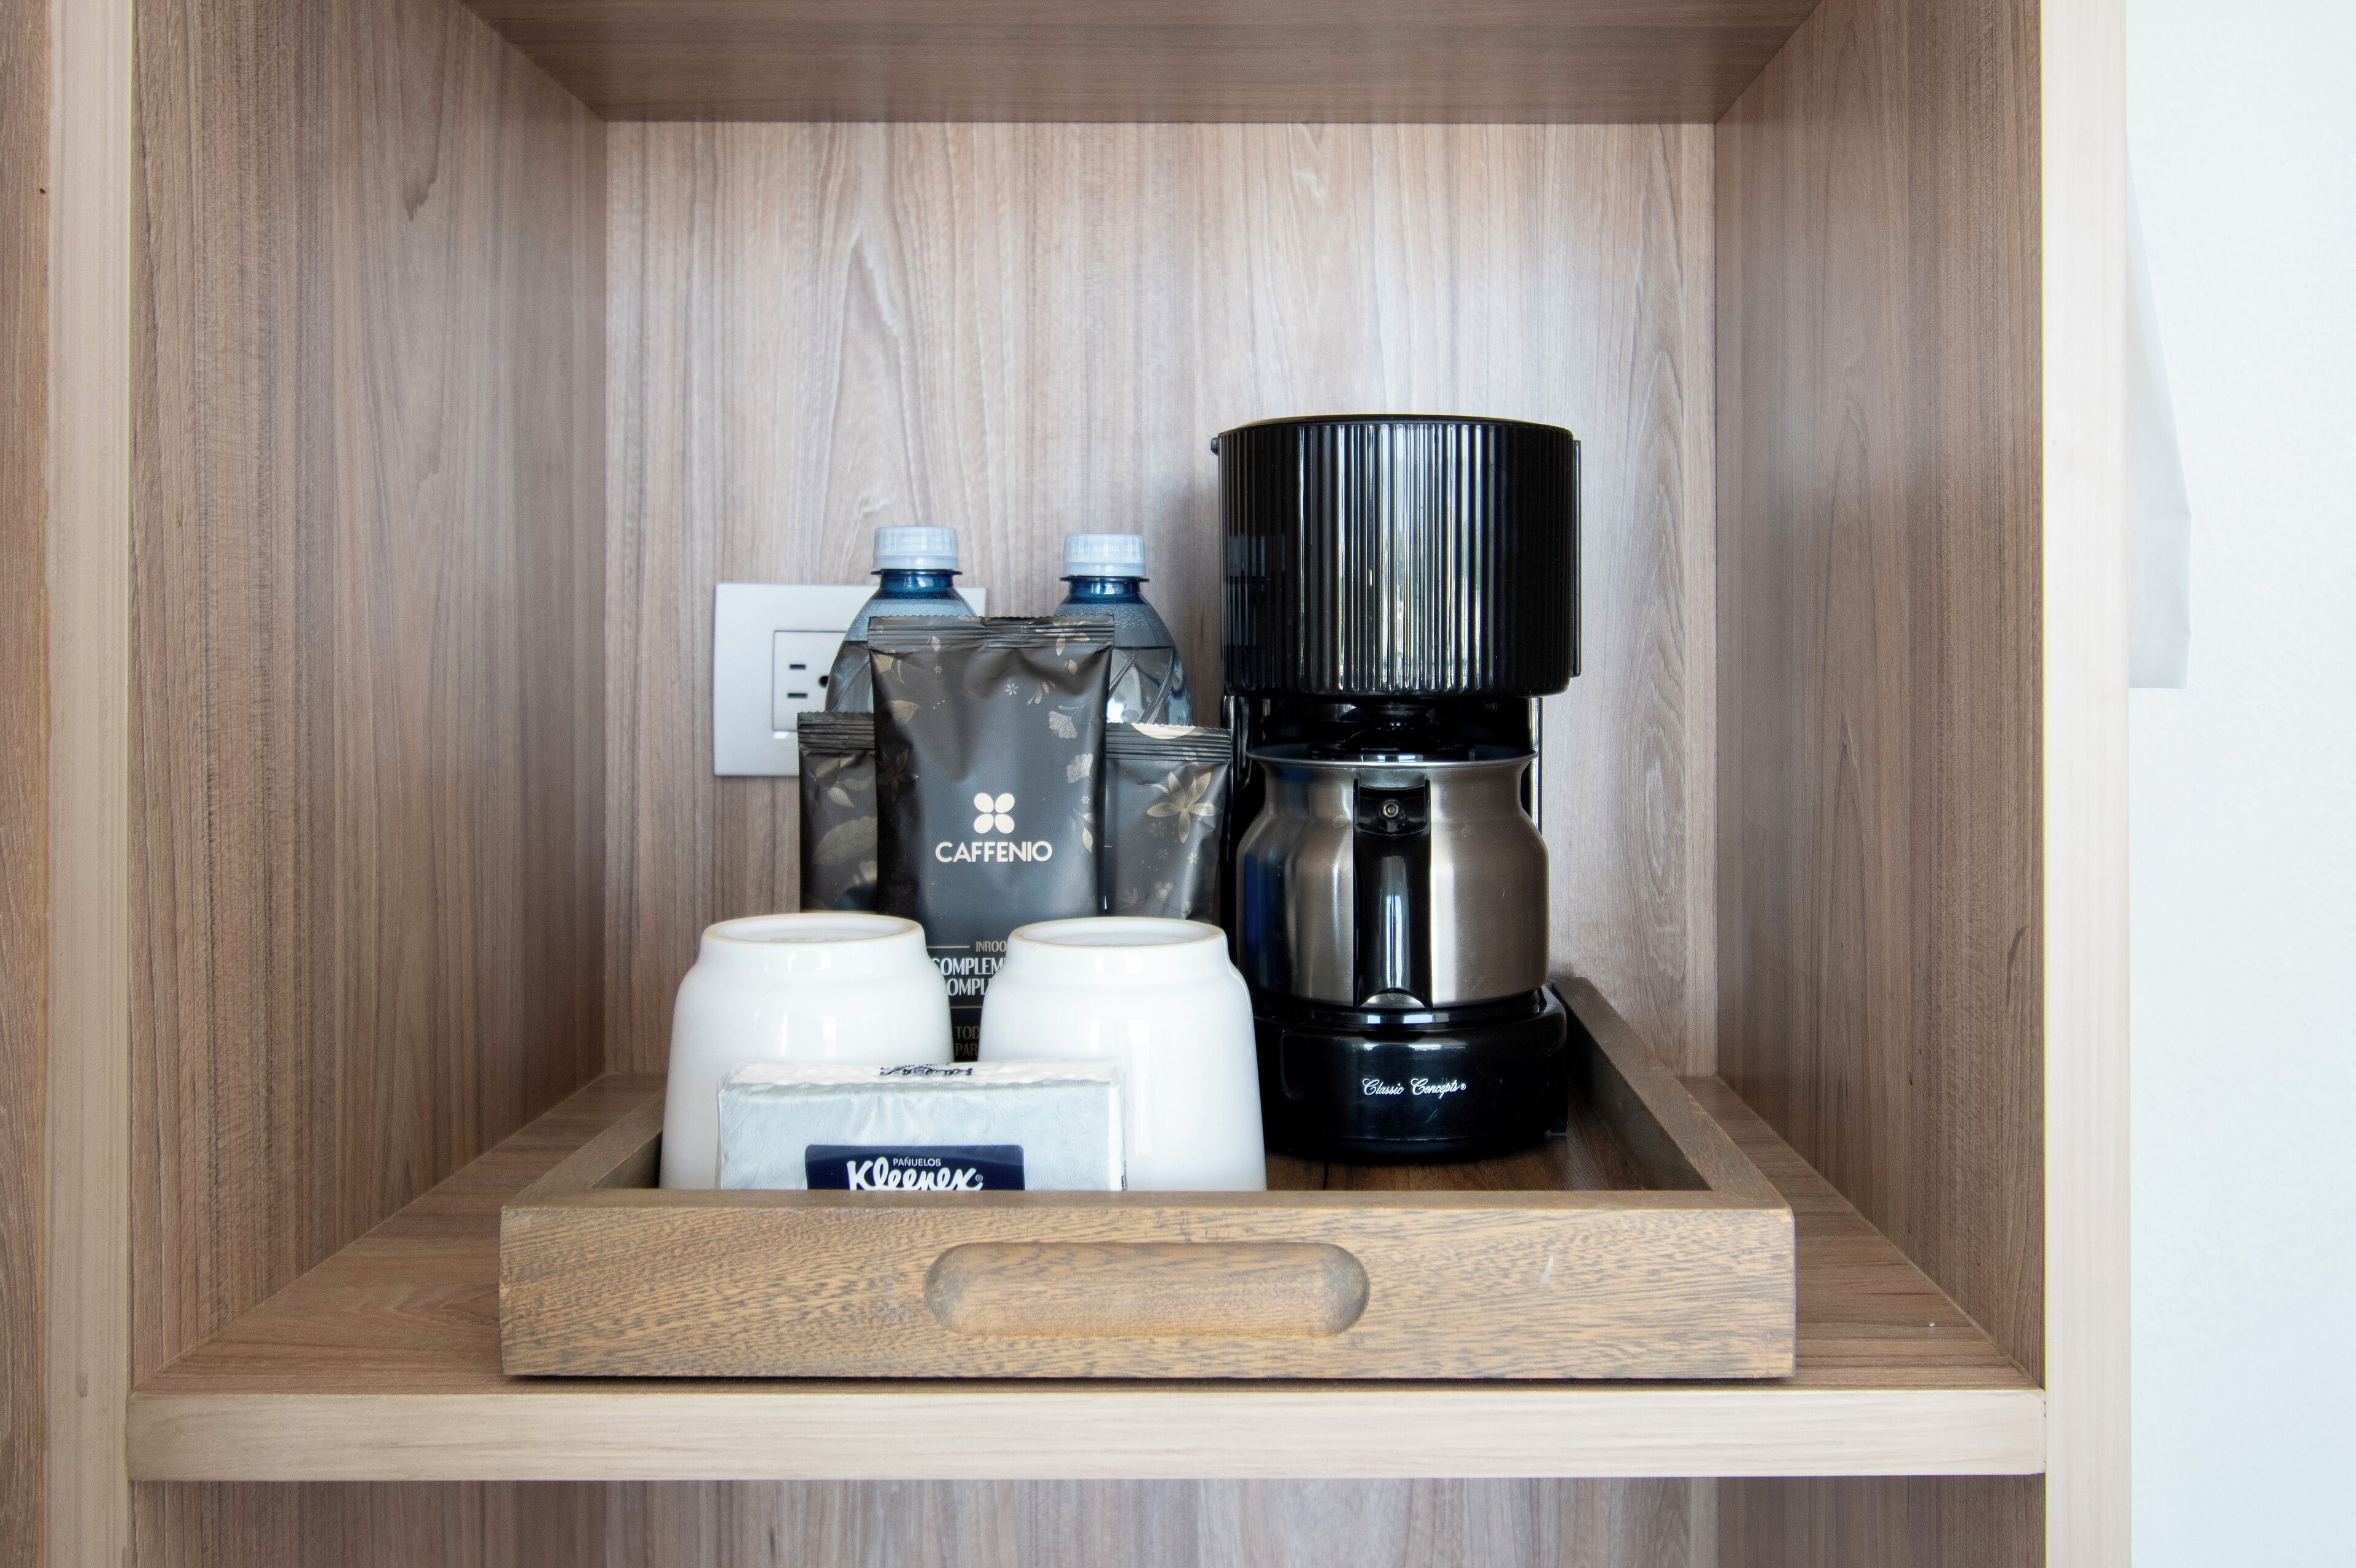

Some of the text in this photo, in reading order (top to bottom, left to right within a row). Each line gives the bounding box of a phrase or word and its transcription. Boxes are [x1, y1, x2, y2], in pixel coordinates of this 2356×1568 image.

[935, 841, 1053, 863] CAFFENIO
[932, 957, 1006, 976] OMPLEM
[946, 978, 993, 996] OMPL
[953, 1043, 979, 1056] PAR
[1361, 1077, 1405, 1096] Classic
[893, 1156, 942, 1167] PAÑUELOS
